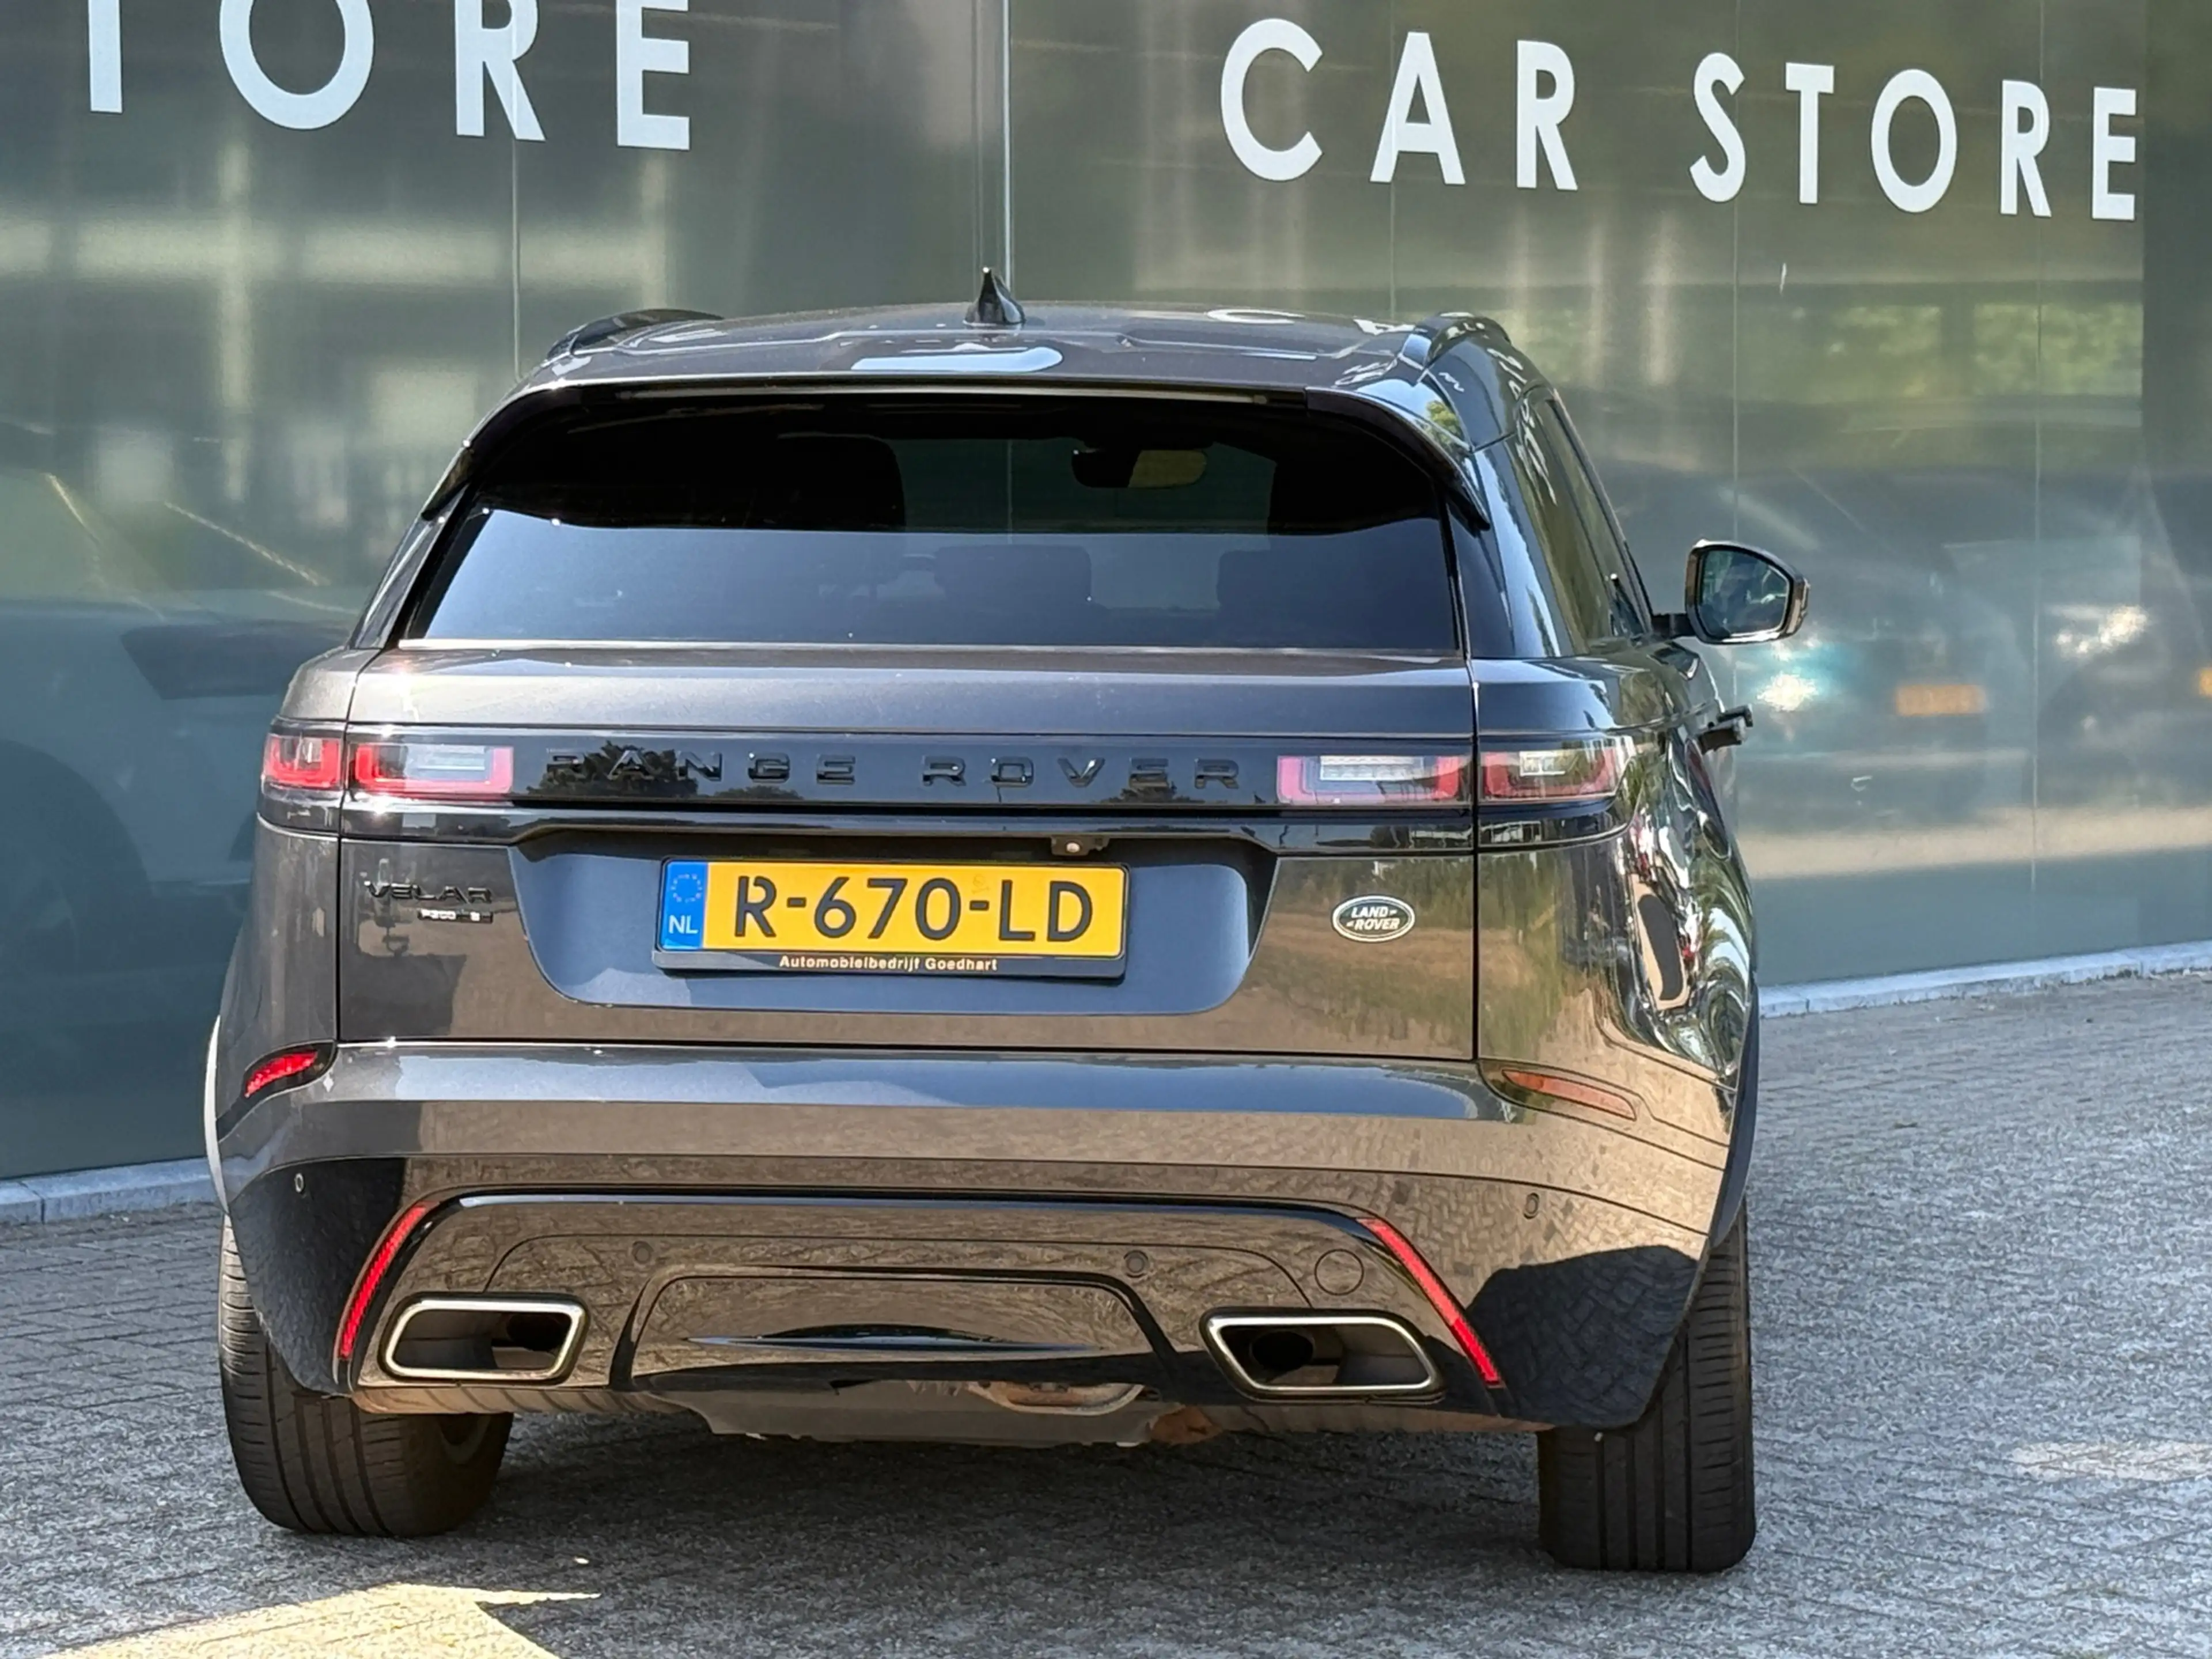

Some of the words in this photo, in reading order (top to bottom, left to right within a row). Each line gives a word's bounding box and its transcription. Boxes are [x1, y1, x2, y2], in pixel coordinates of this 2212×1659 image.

[1220, 17, 1578, 191] CAR
[1689, 52, 2137, 221] STORE
[546, 748, 856, 785] RANGE
[922, 755, 1240, 789] ROVER
[363, 880, 493, 904] VELAR
[734, 875, 1093, 942] R-670-LD
[1351, 906, 1388, 918] LAND
[668, 914, 699, 934] NL
[1354, 918, 1400, 931] ROVER
[779, 955, 921, 972] Automobielbedrijf
[925, 957, 998, 971] Goedhart
